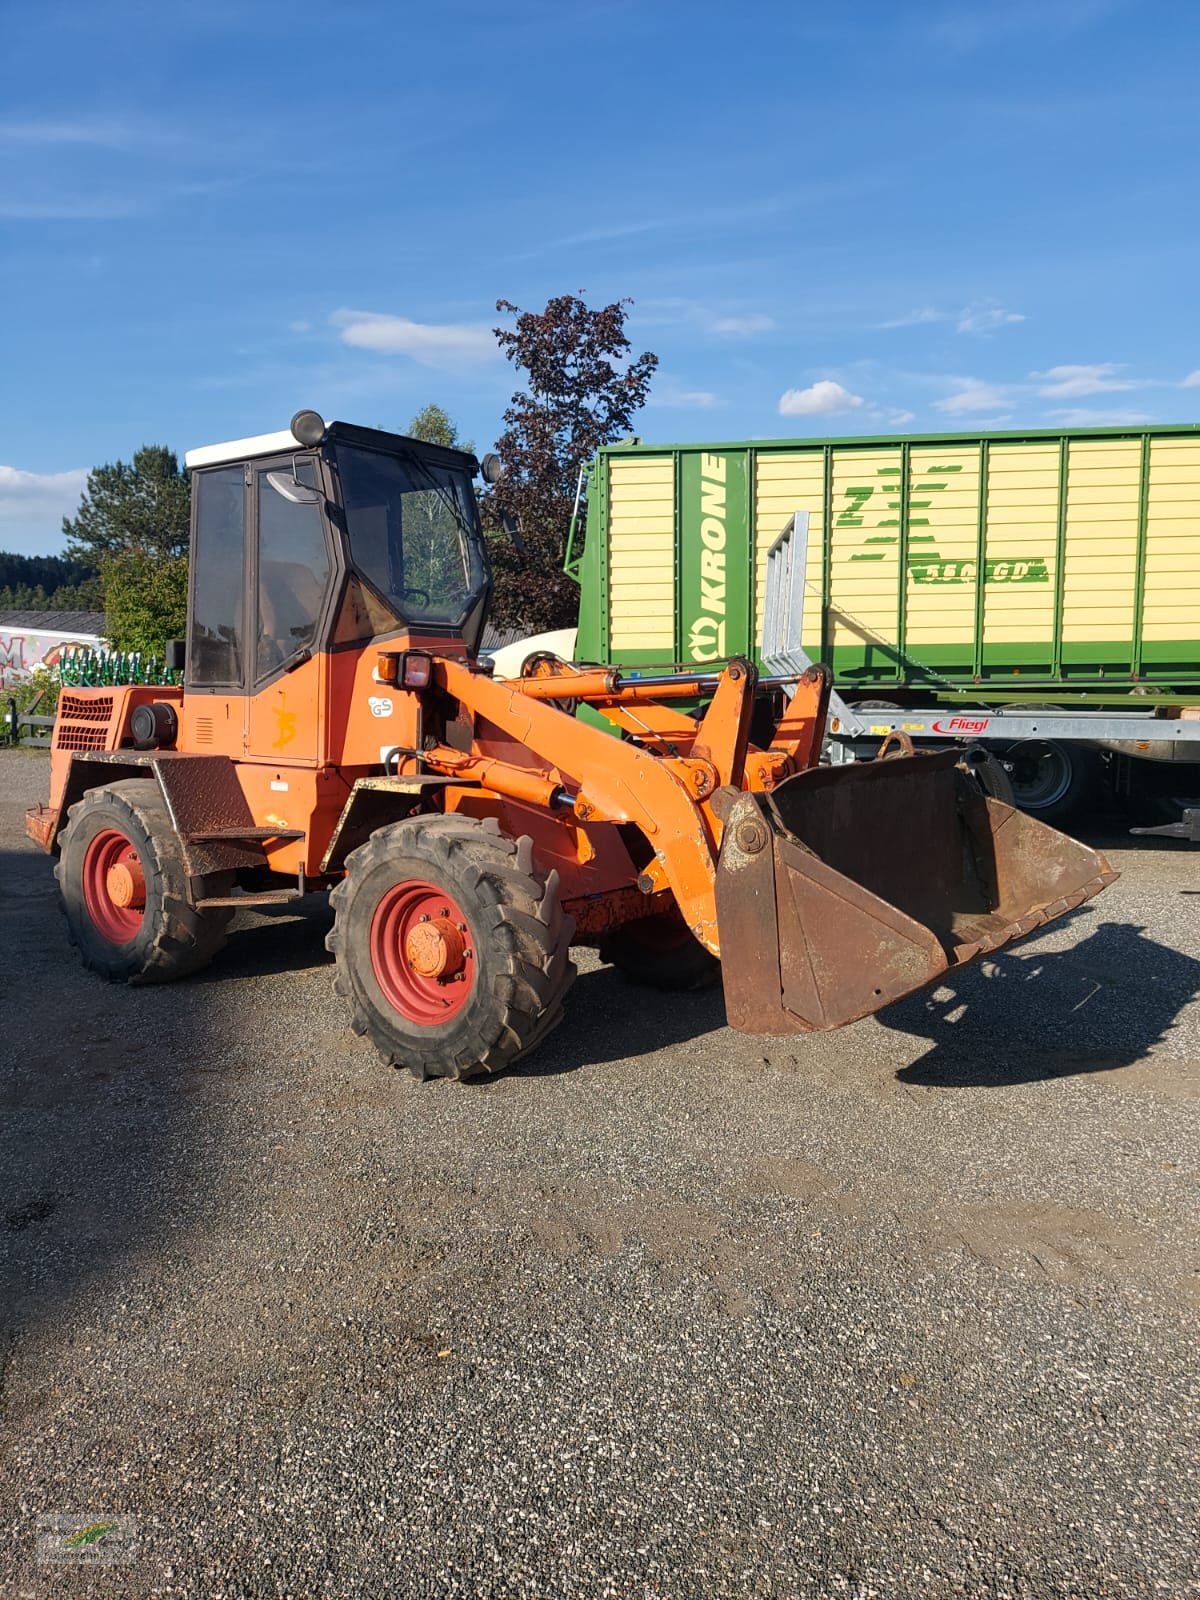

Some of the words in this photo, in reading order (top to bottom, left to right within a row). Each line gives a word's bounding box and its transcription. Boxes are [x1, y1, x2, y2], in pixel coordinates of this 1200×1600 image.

[701, 453, 726, 615] KRONE
[373, 699, 391, 715] GS
[949, 718, 989, 731] Fliegl
